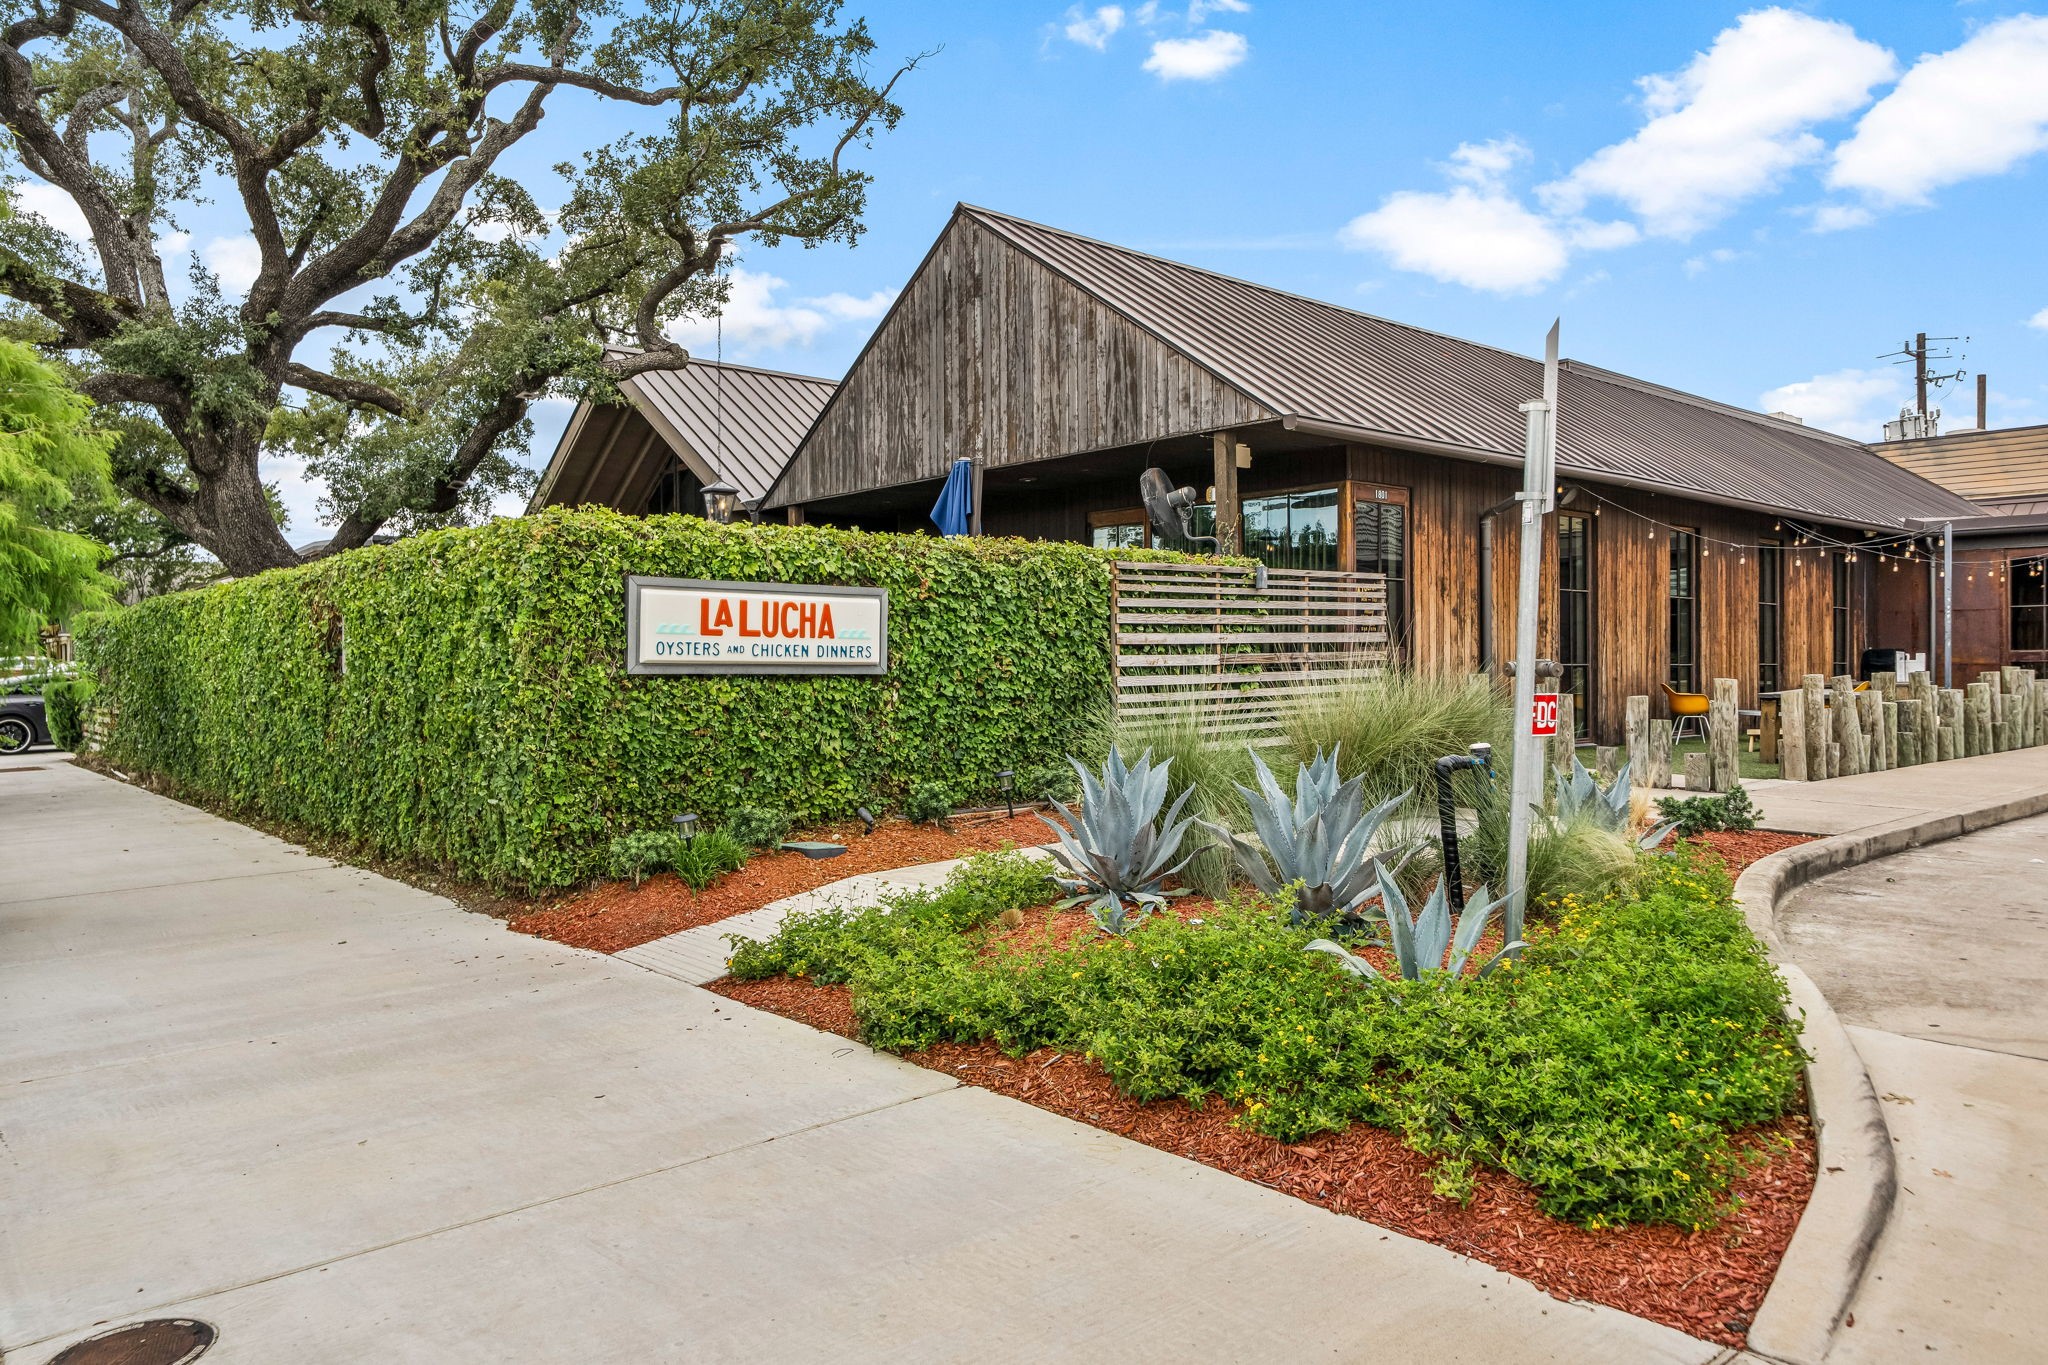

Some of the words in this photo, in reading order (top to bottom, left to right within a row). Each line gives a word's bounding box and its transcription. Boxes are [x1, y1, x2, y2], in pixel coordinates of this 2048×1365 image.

[700, 598, 734, 636] LA
[738, 599, 836, 639] LUCHA
[655, 641, 720, 657] OYSTERS
[727, 645, 745, 654] AND
[751, 643, 809, 658] CHICKEN
[817, 645, 872, 659] DINNERS
